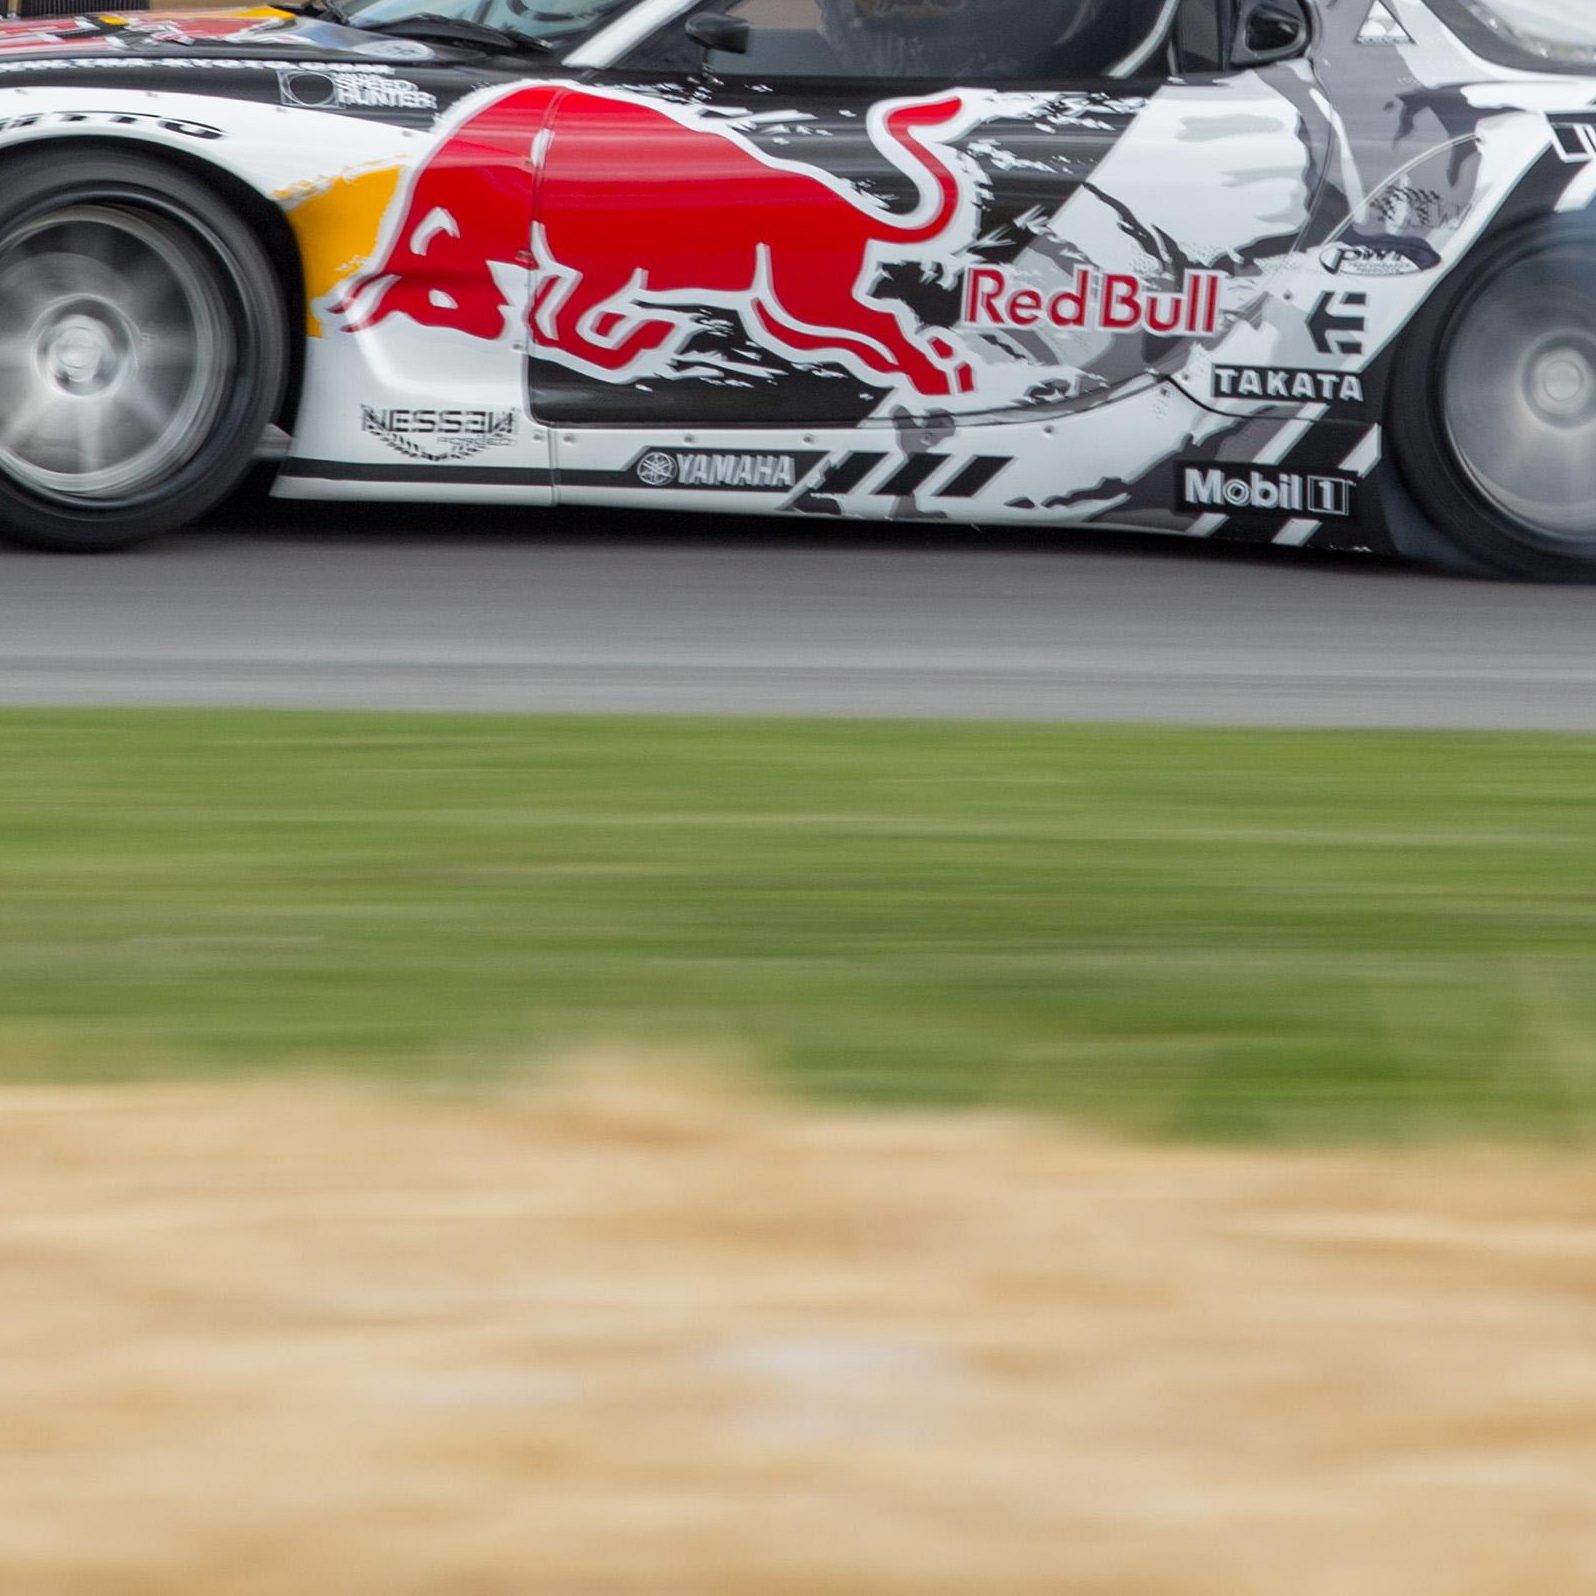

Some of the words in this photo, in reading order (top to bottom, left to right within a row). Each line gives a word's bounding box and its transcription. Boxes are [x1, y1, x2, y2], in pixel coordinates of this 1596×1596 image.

[964, 267, 1090, 327] Red
[1098, 273, 1220, 333] Bull
[1215, 369, 1364, 402] TAKATA
[676, 453, 796, 487] YAMAHA
[1184, 467, 1303, 511] Mobil
